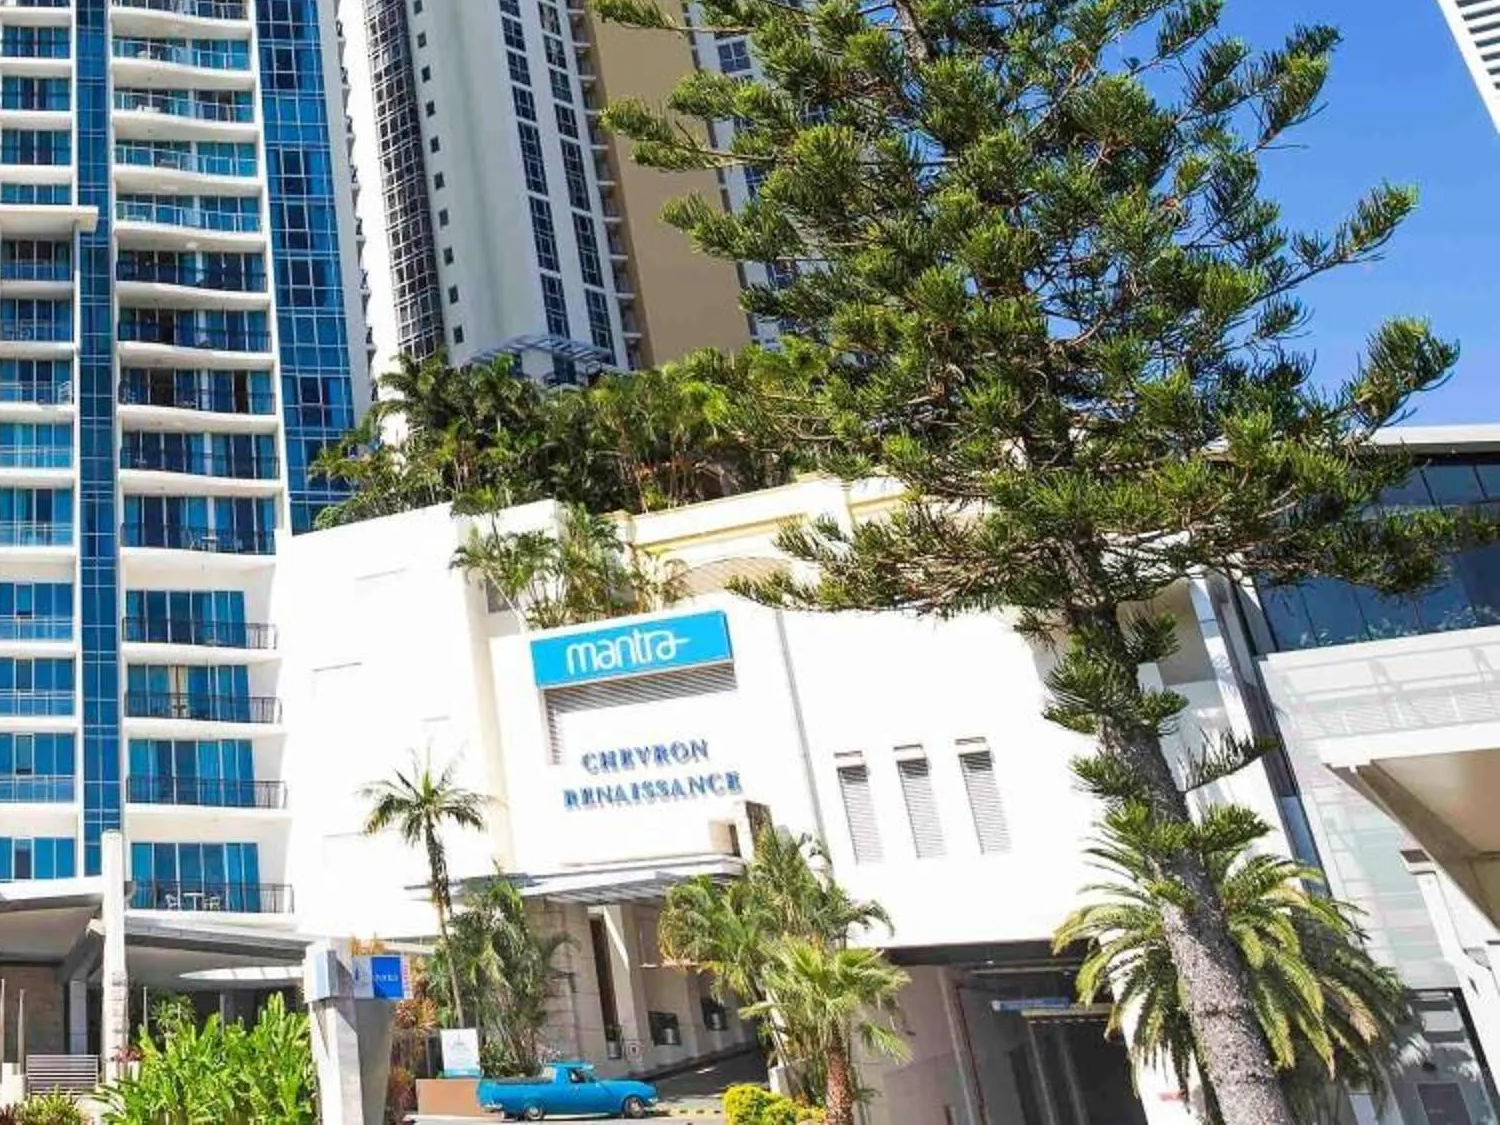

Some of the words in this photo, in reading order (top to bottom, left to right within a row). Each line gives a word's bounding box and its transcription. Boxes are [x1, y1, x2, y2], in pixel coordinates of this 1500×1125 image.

[566, 627, 691, 675] mantra
[581, 738, 710, 775] CHEVRON
[563, 770, 743, 812] RENAISSANCE
